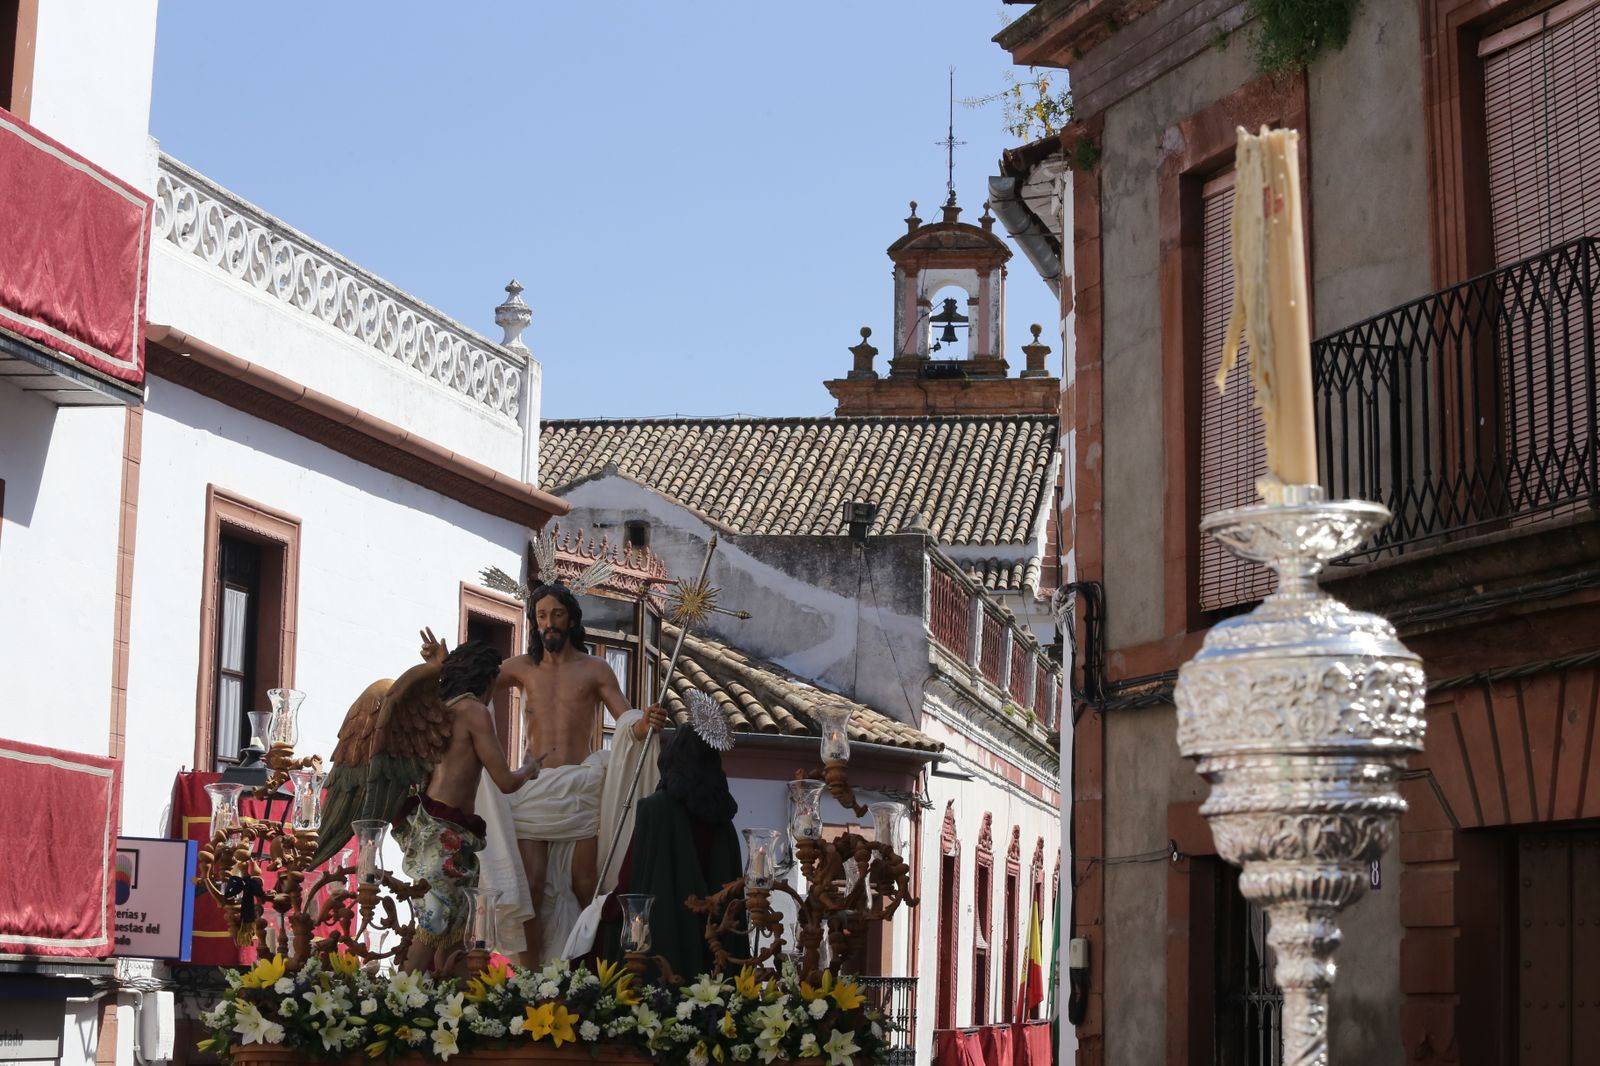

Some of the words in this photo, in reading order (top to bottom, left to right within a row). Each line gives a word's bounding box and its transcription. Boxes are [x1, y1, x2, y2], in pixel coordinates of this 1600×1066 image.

[115, 908, 139, 920] erías
[140, 911, 147, 923] y
[114, 922, 144, 934] uestas
[145, 923, 161, 935] del
[114, 934, 131, 946] ado
[0, 1028, 24, 1047] stado
